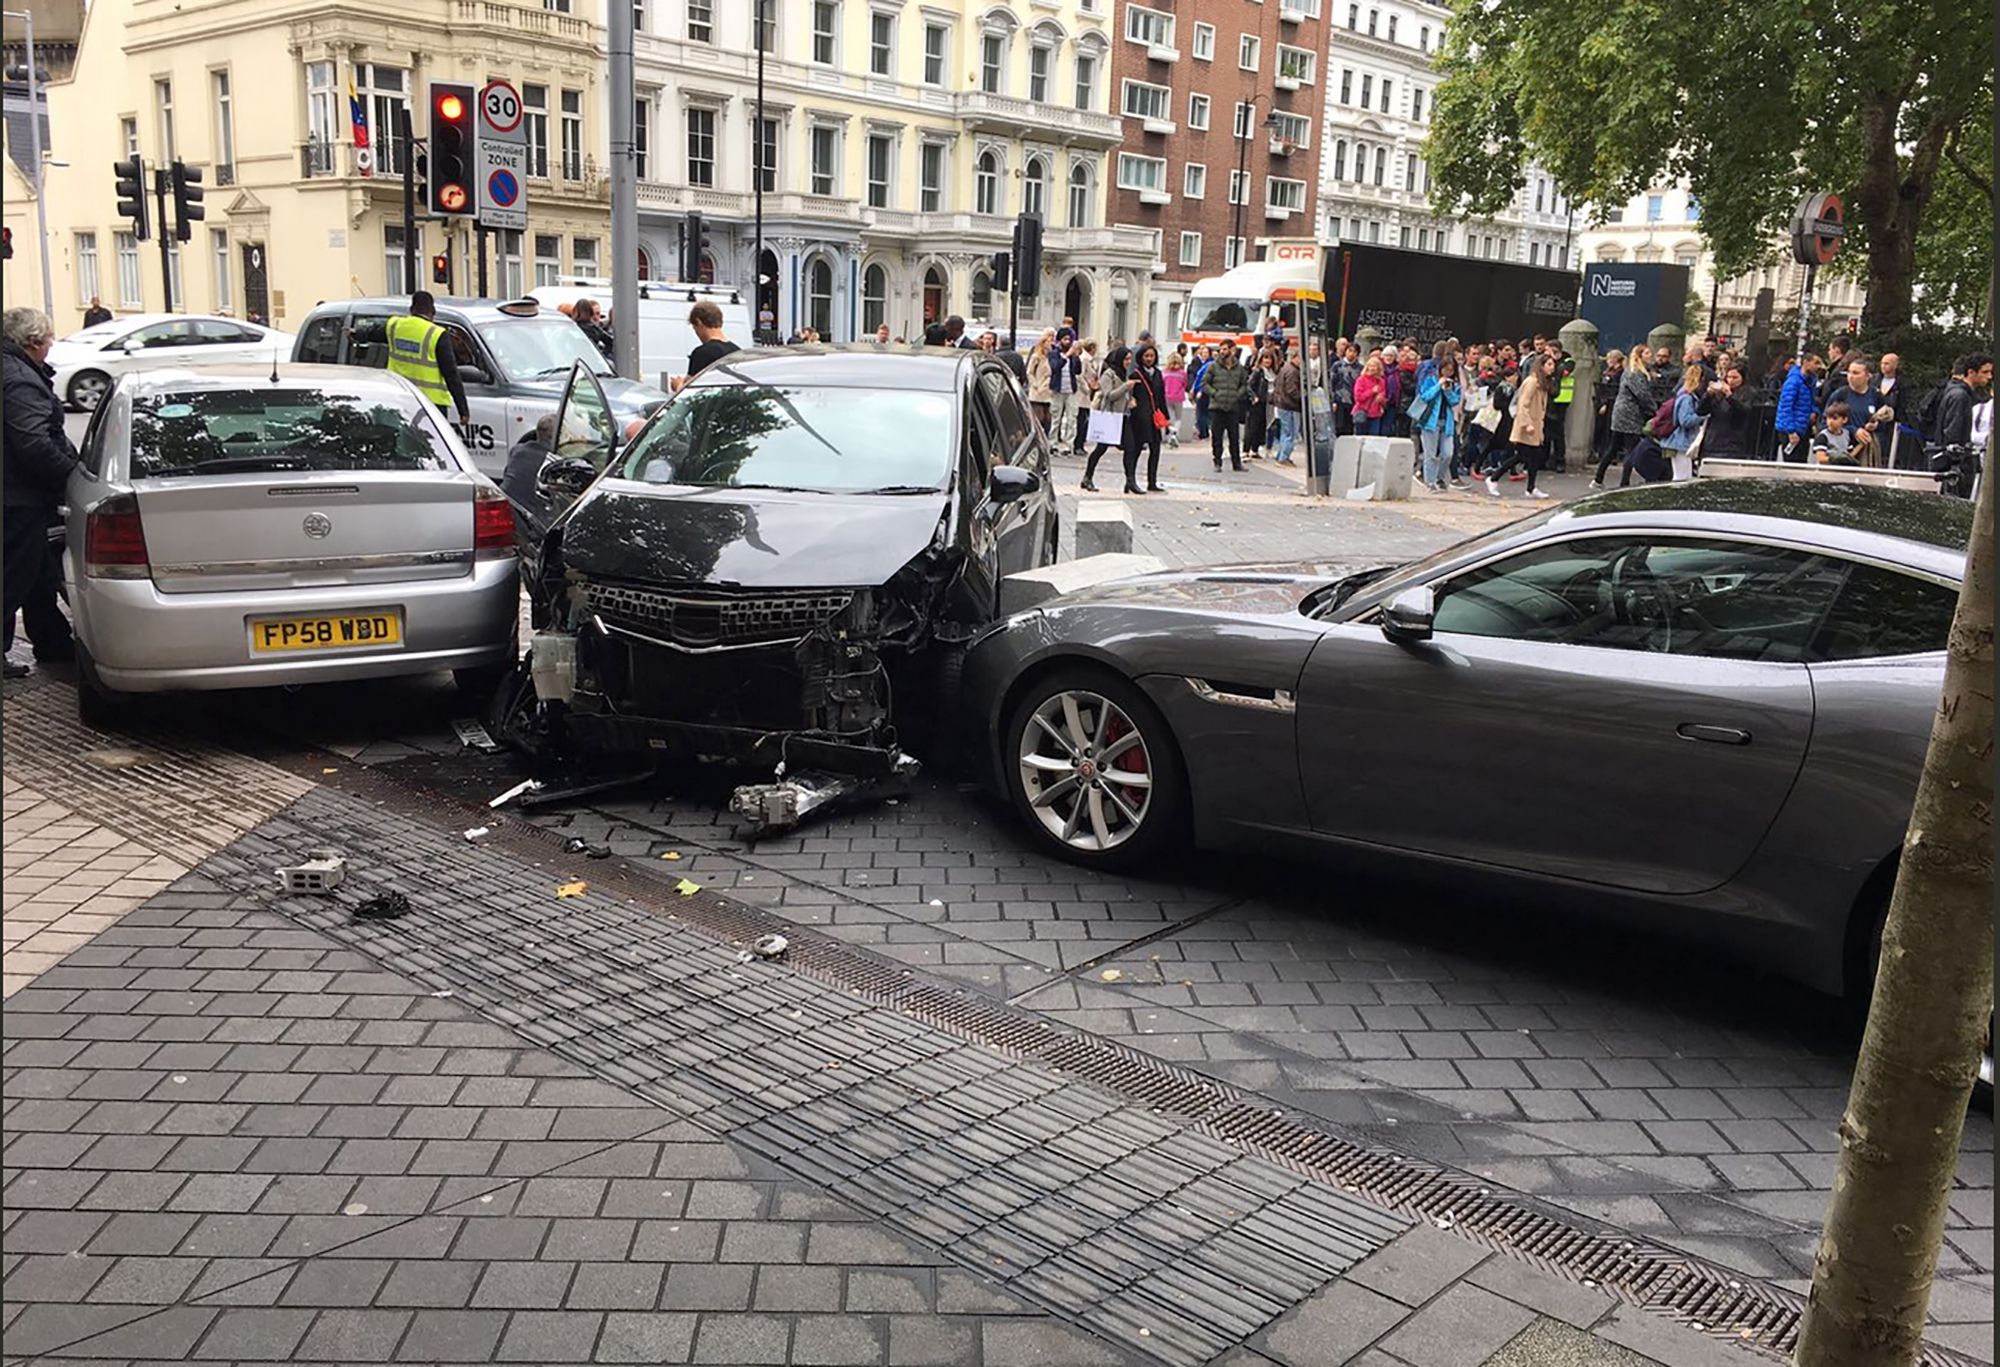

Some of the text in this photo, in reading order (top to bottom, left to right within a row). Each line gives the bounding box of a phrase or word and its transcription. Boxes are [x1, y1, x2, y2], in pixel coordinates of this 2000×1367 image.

[488, 94, 517, 118] 30
[482, 142, 524, 156] Controlled
[488, 153, 517, 168] ZONE
[1278, 246, 1315, 260] QTR
[1358, 309, 1447, 329] A SAFETY SYSTEM THAT
[264, 620, 333, 646] FP58
